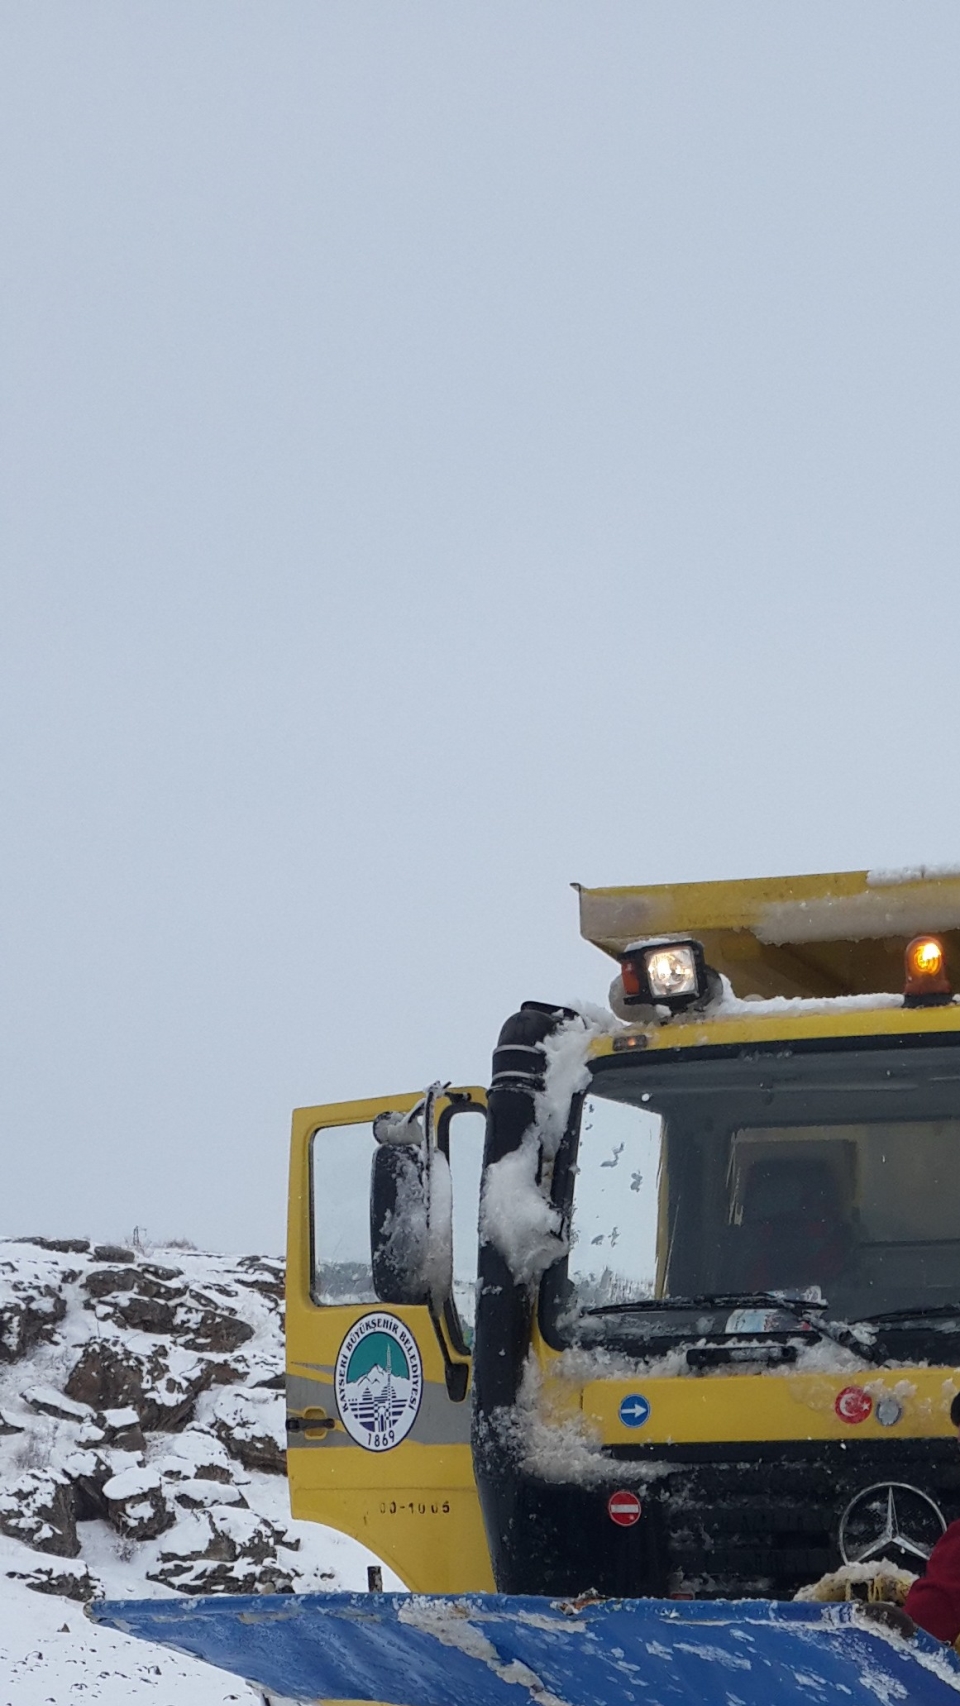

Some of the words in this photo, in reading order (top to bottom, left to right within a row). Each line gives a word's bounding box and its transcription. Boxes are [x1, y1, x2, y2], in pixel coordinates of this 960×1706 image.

[339, 1353, 349, 1413] KAYSERİ
[346, 1318, 399, 1352] BÜYÜKŞEHİR
[400, 1331, 421, 1411] BELEDİYESİ
[367, 1430, 395, 1448] 1869
